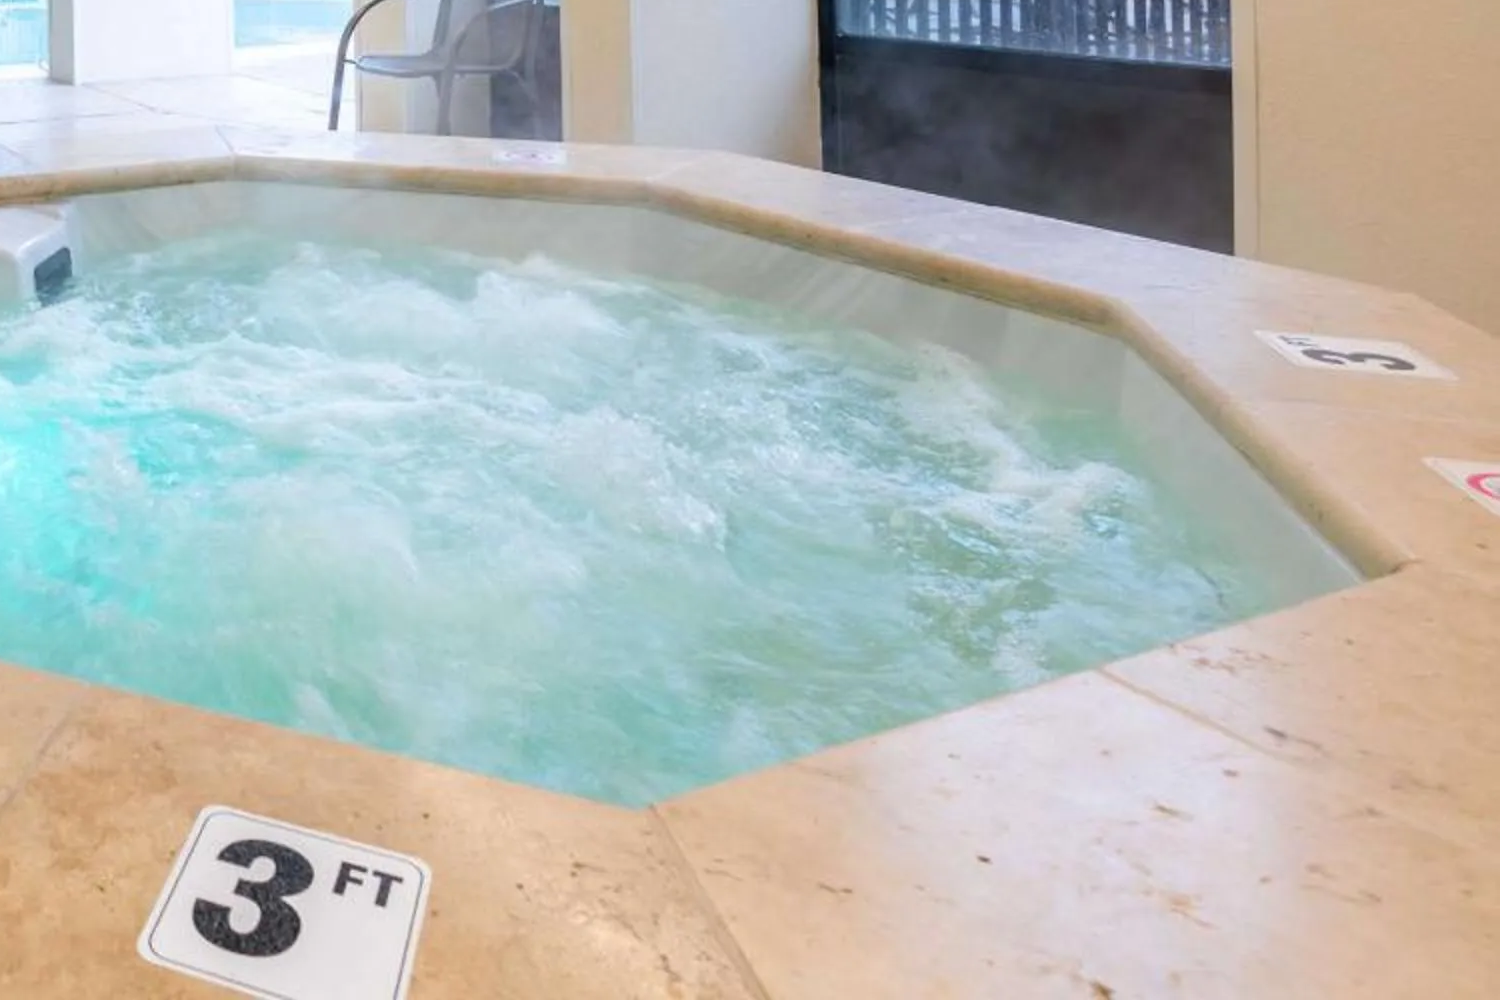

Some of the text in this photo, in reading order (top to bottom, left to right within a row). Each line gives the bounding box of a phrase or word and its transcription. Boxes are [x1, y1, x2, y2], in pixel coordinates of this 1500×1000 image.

[1301, 348, 1417, 371] 3
[191, 838, 404, 958] 3 FT
